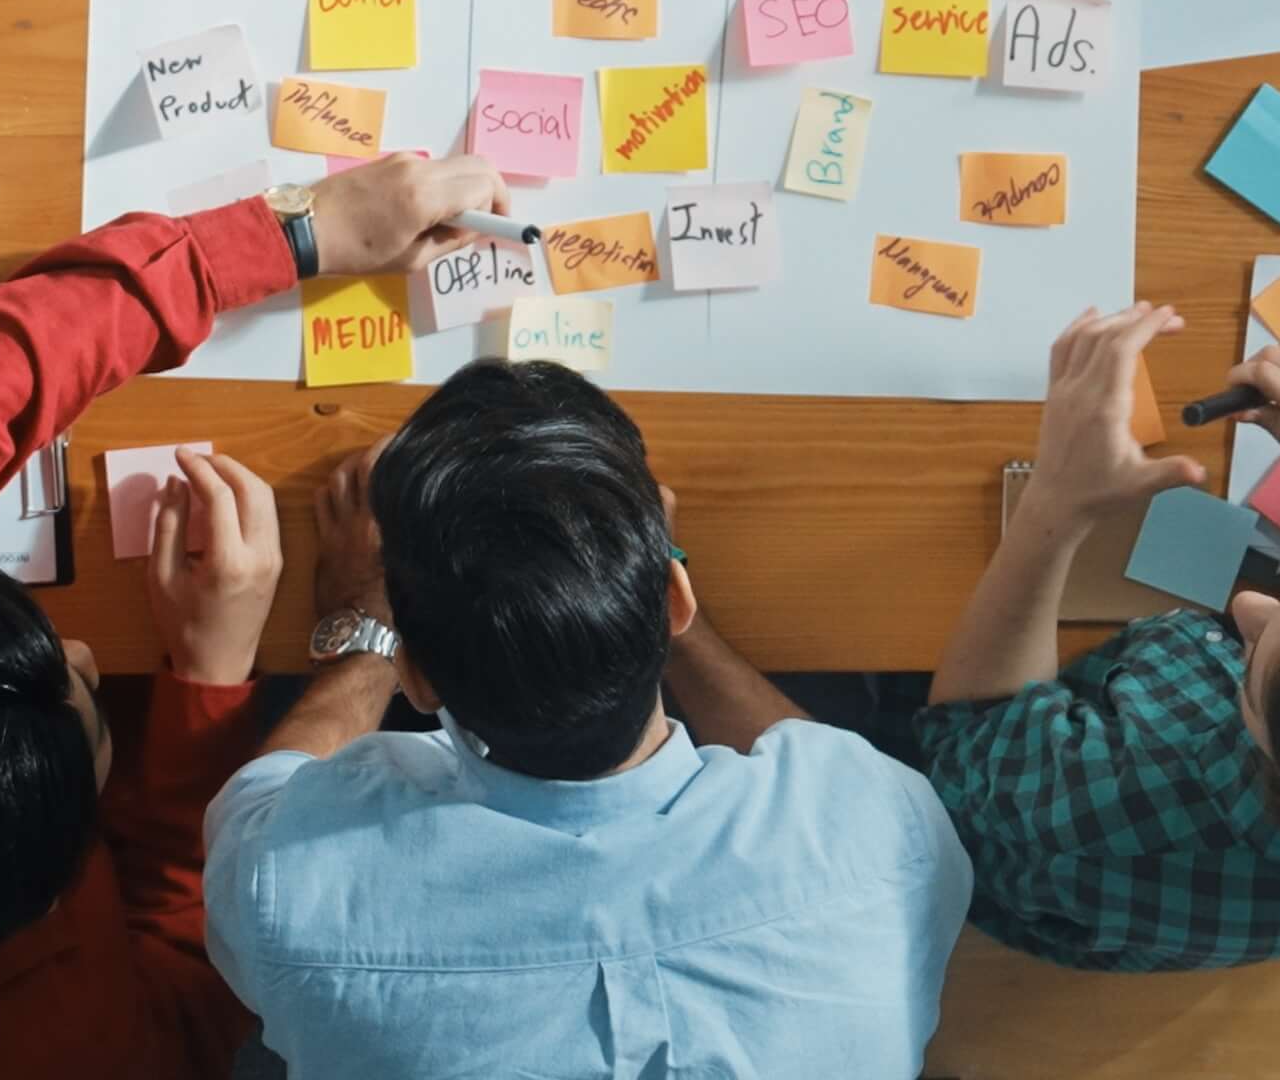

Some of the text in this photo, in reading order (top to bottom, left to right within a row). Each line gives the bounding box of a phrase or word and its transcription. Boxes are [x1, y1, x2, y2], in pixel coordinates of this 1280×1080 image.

[148, 53, 204, 81] New
[158, 80, 254, 121] Product
[806, 92, 856, 186] Brand
[670, 200, 763, 245] Invest
[312, 311, 409, 355] MEDIA
